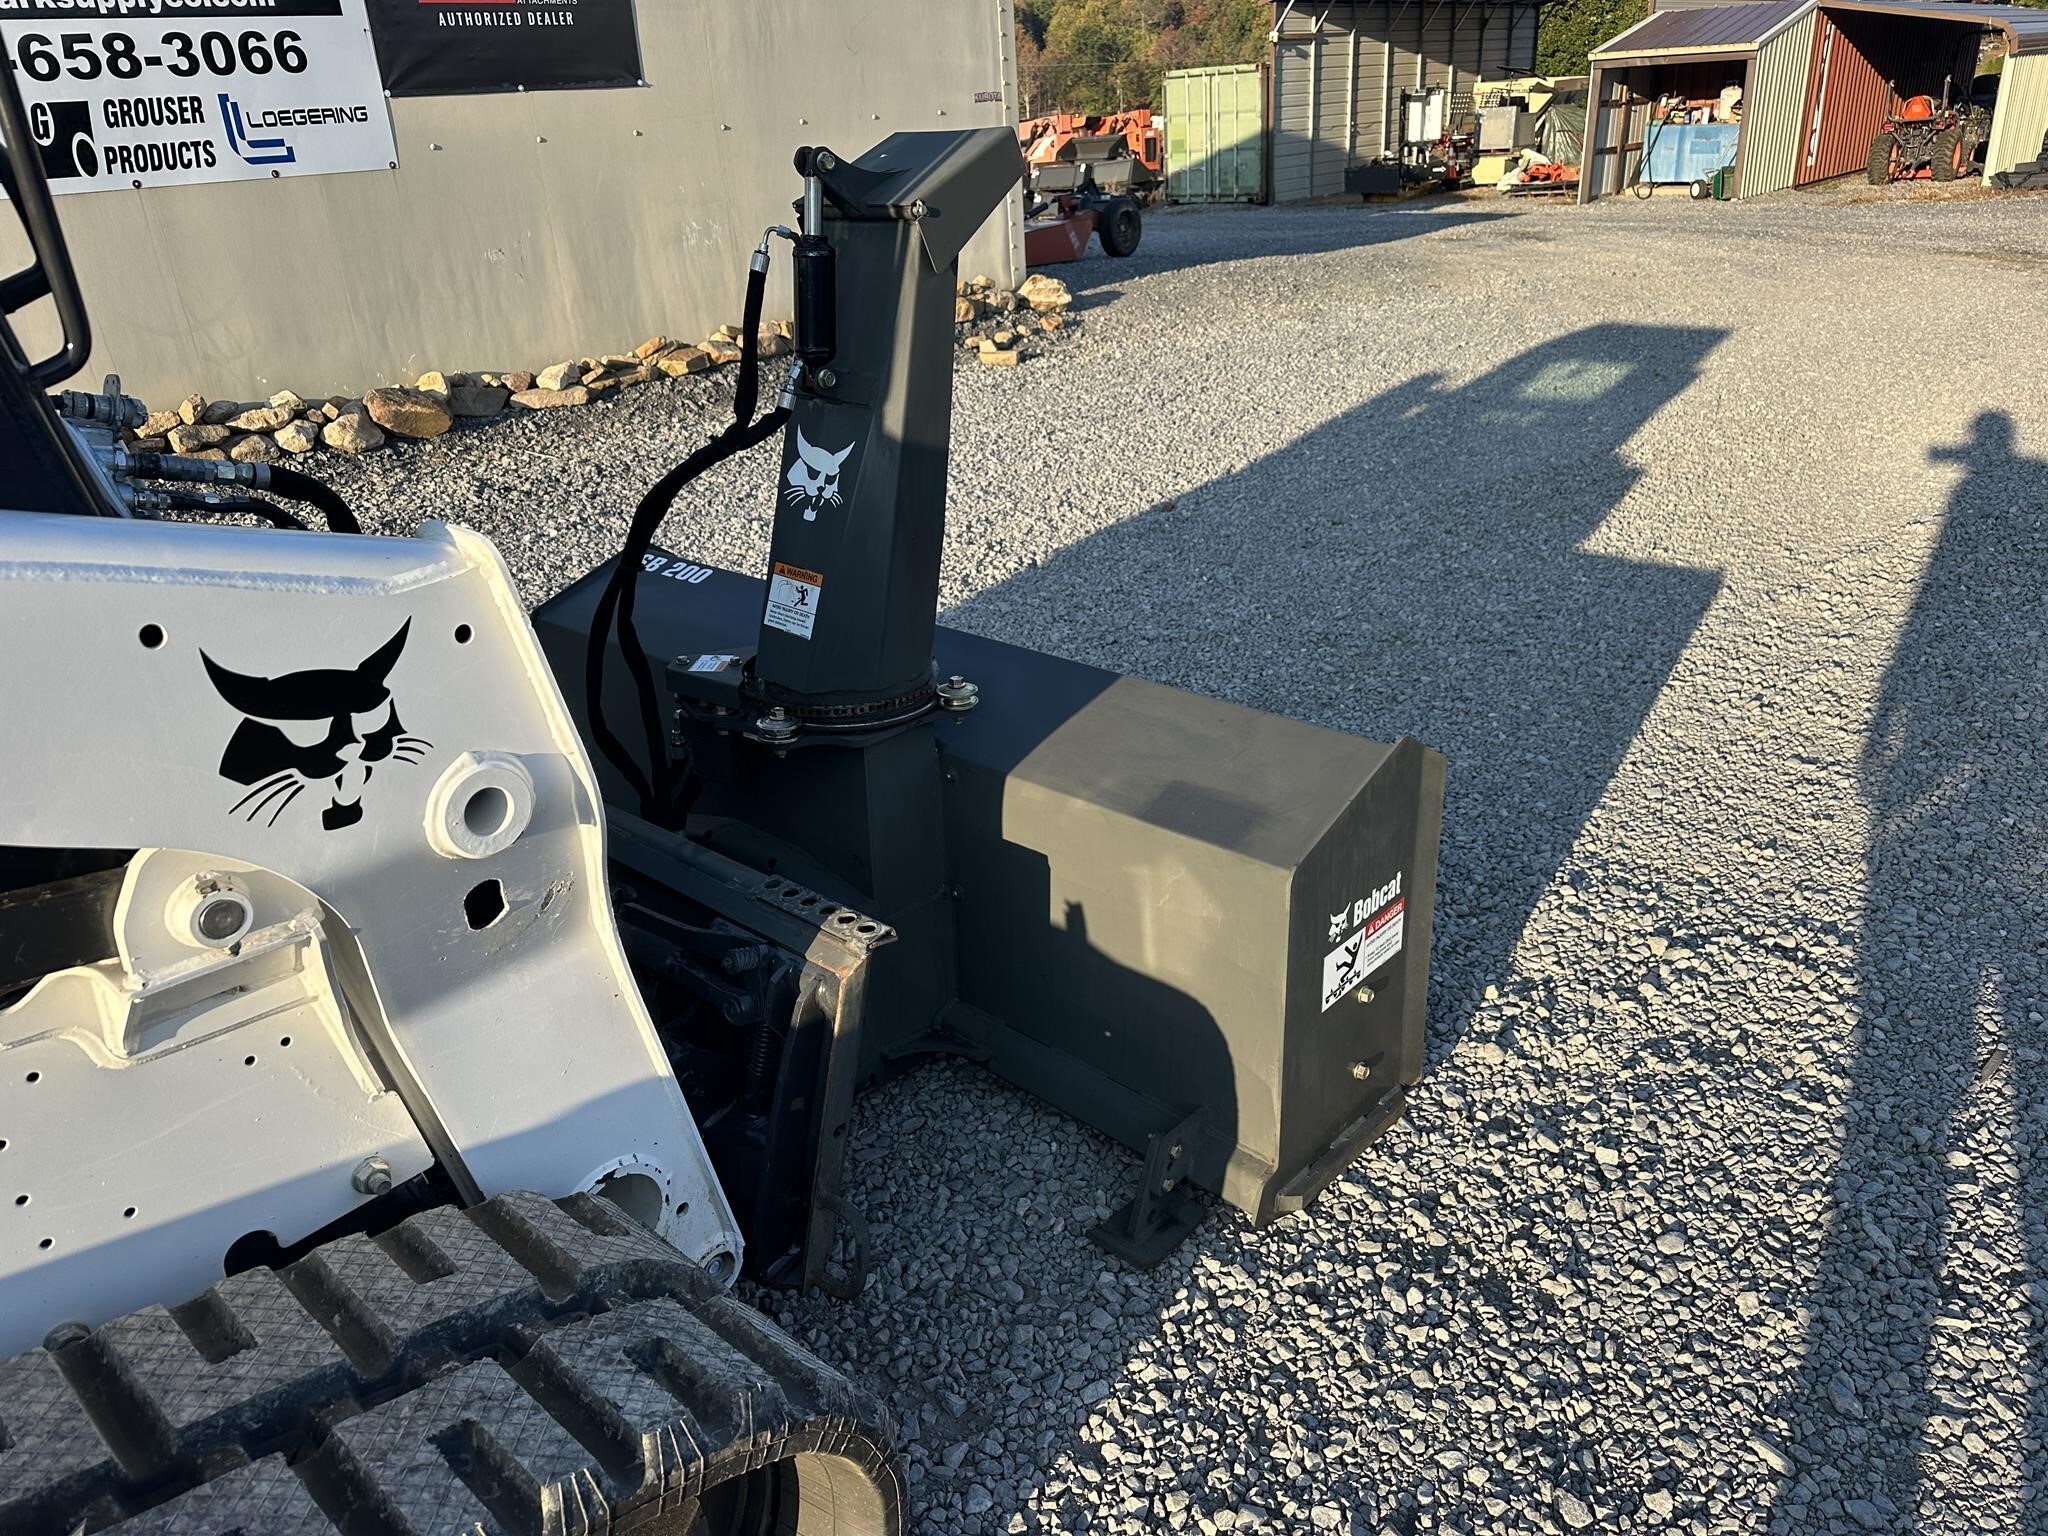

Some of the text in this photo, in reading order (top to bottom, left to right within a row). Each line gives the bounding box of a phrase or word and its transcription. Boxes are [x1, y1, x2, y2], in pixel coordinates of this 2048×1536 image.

[438, 11, 575, 27] AUTHORIZED DEALER
[102, 95, 206, 129] GROUSER
[246, 105, 369, 128] LOEGERING
[103, 139, 217, 175] PRODUCTS
[661, 562, 714, 584] 200
[787, 567, 818, 583] WARNING
[1353, 870, 1402, 928] Bobcat
[1375, 902, 1403, 930] DANGER
